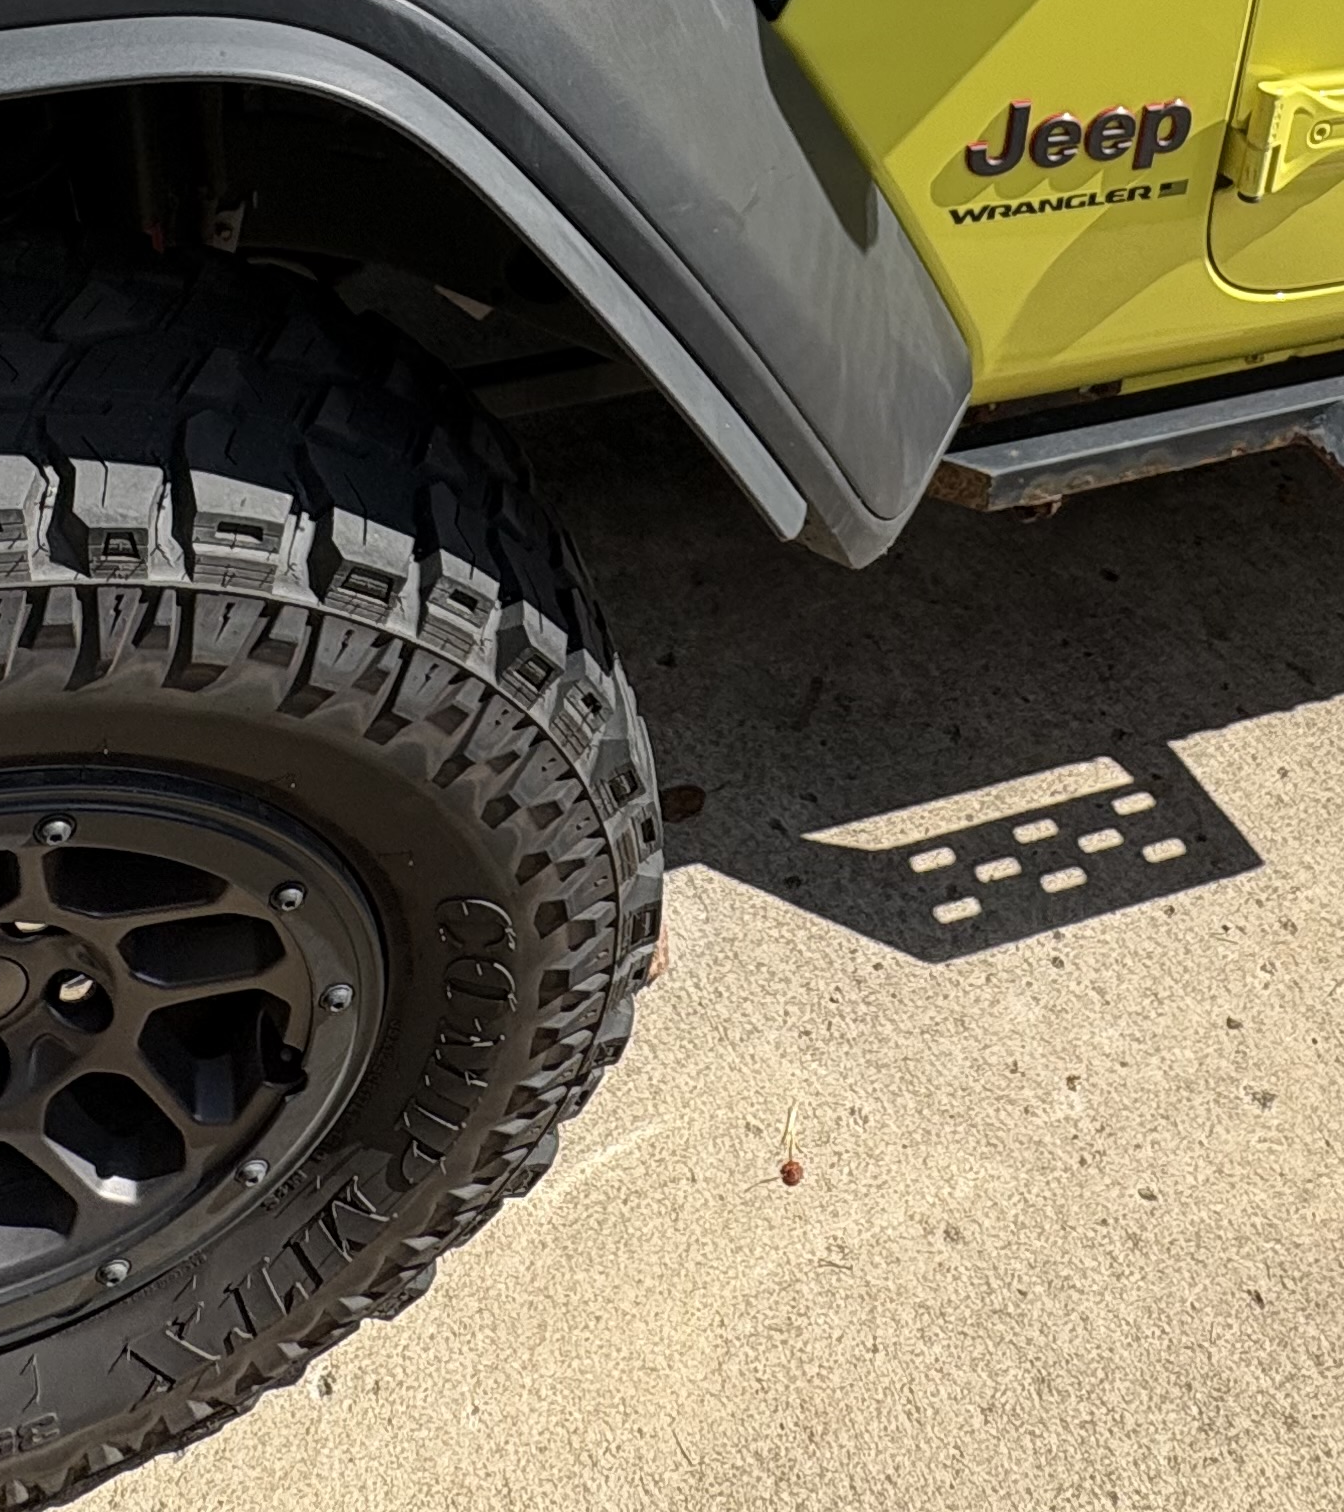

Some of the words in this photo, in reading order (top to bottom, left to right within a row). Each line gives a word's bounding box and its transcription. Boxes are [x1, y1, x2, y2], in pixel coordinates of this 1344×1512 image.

[964, 98, 1193, 177] Jeep
[949, 185, 1153, 226] WRANGLER
[387, 897, 518, 1191] COMP
